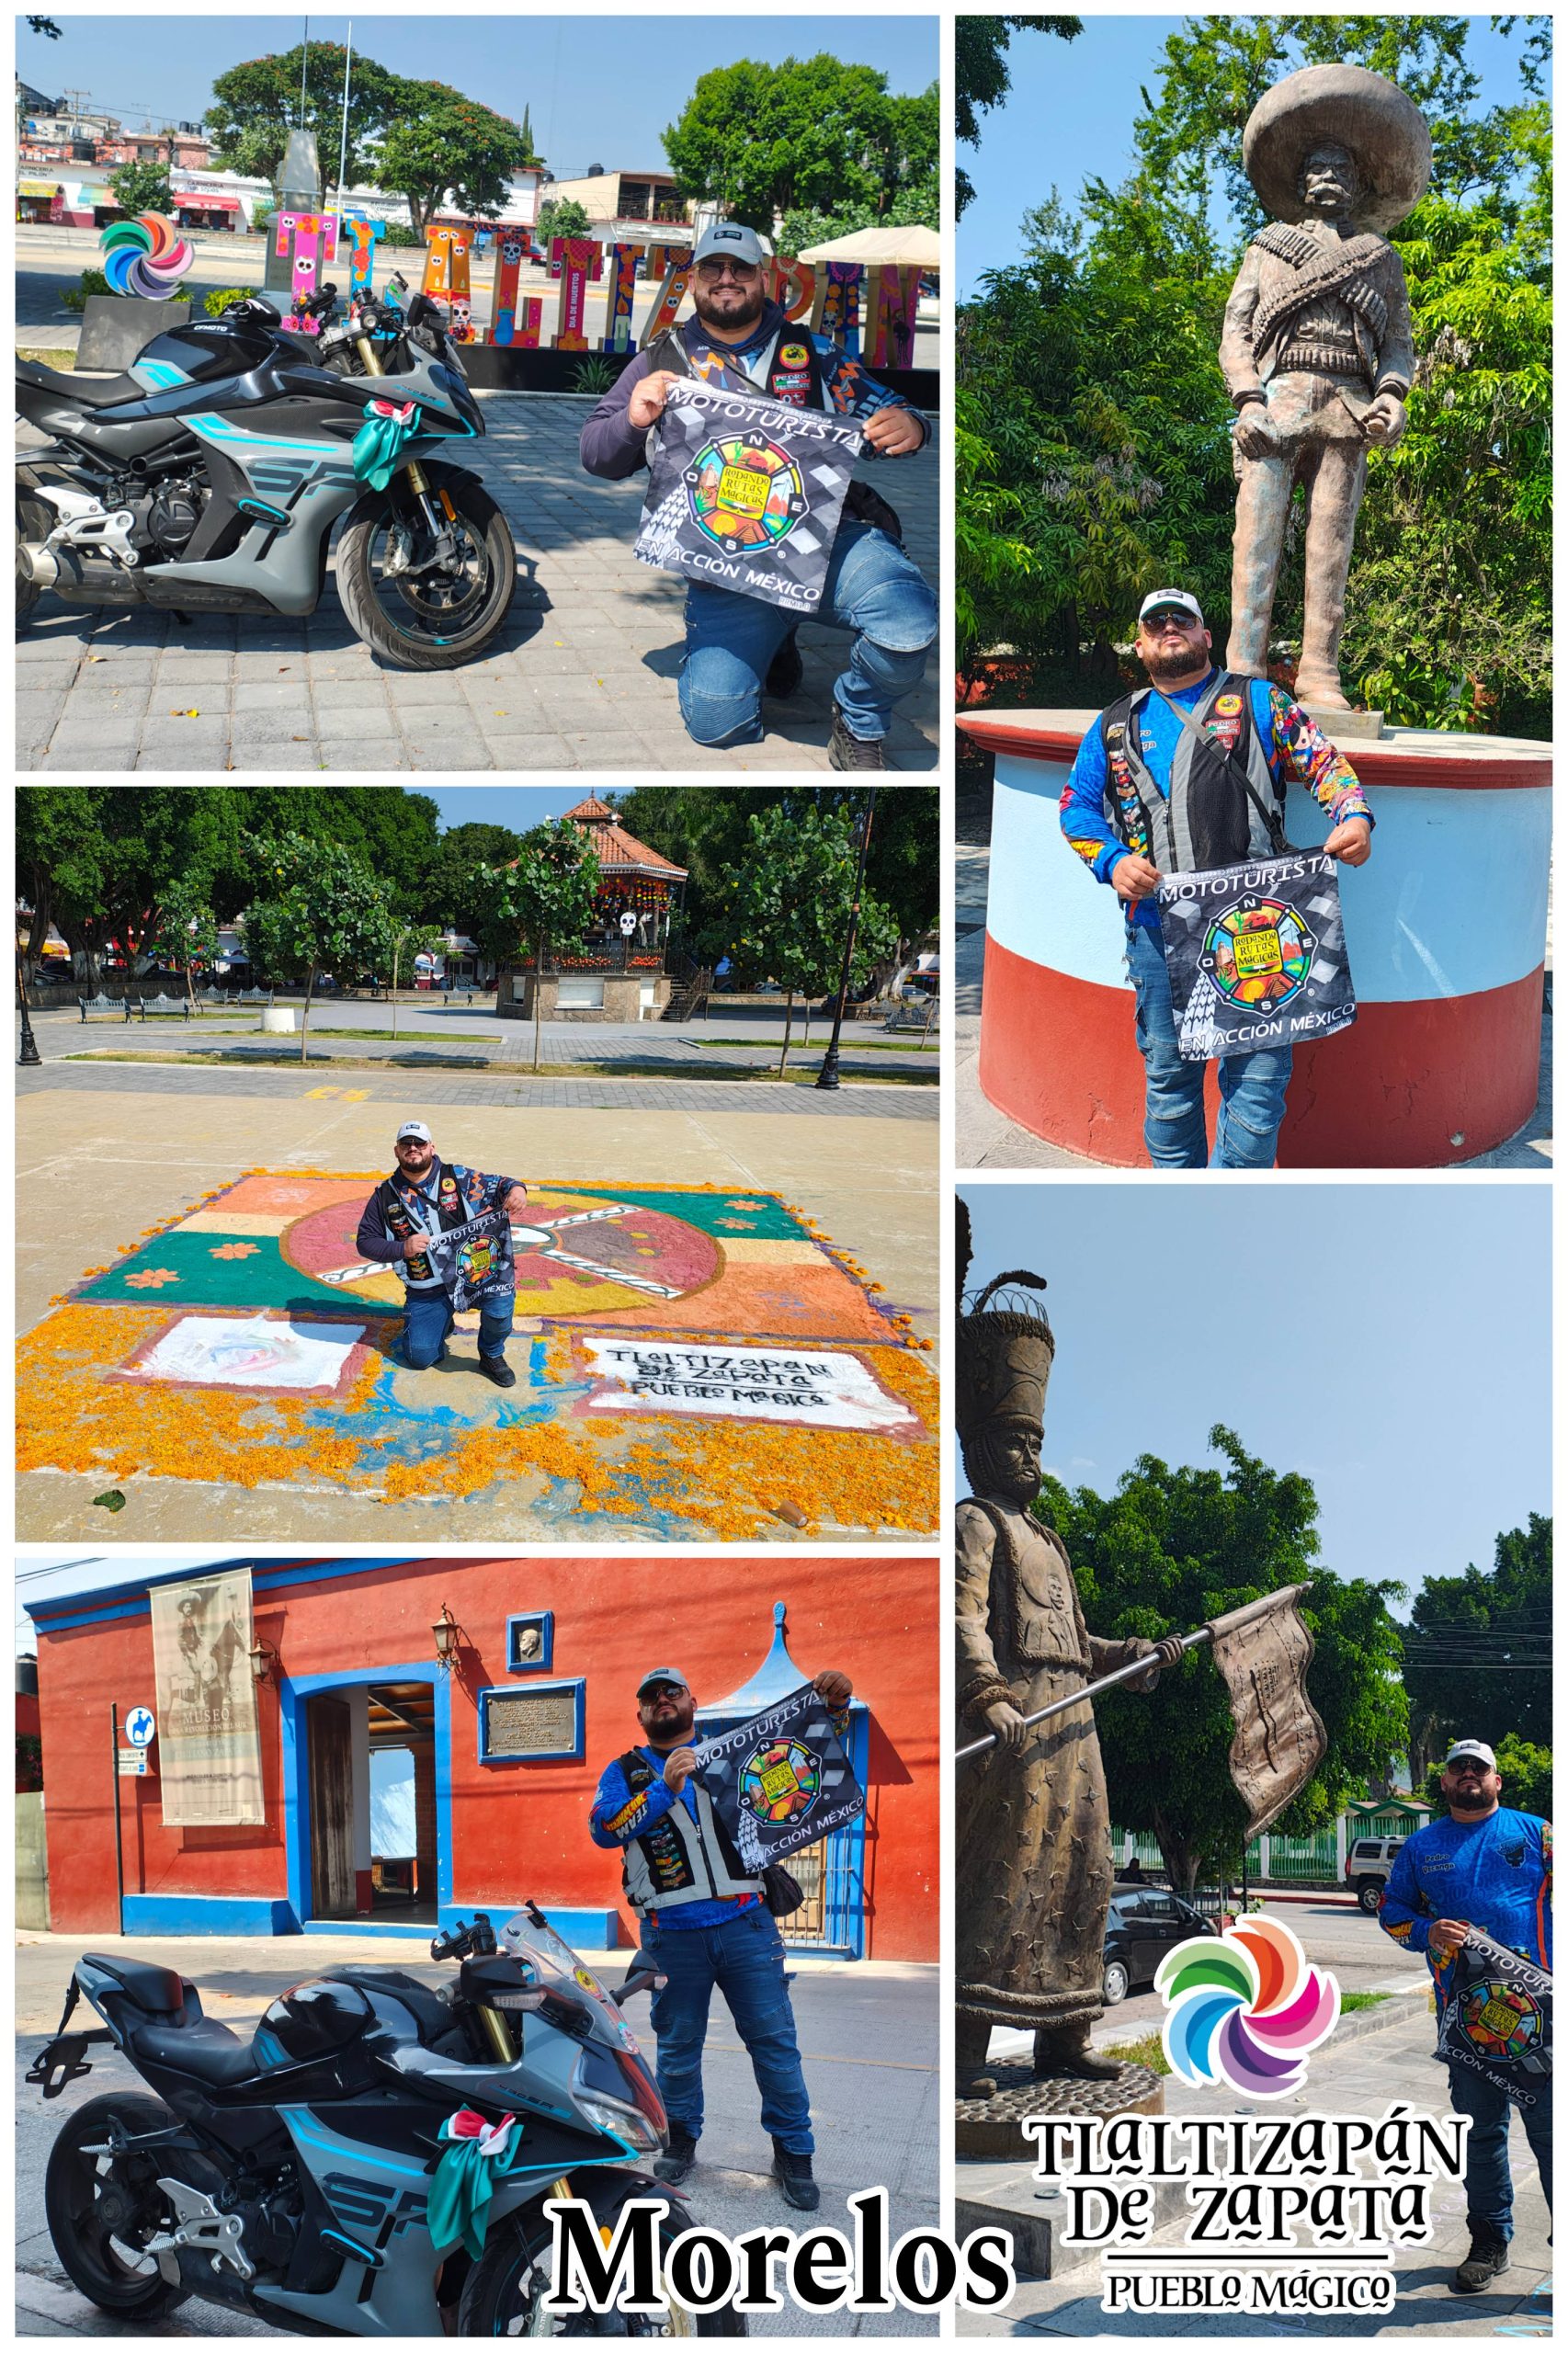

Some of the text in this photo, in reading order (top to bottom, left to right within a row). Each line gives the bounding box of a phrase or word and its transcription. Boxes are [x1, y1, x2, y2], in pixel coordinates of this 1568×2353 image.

[568, 272, 580, 328] DIA DE MUERTOS
[777, 373, 807, 381] PEDRO
[669, 386, 862, 448] MOTOTURISTA
[748, 435, 764, 447] N
[687, 472, 699, 483] O
[791, 501, 803, 512] E
[725, 539, 737, 551] S
[636, 539, 821, 601] EN ACCIÓN MÉXICO
[1159, 854, 1335, 904] MOTOTURISTA
[1243, 898, 1256, 909] N
[1302, 938, 1313, 948] E
[1202, 958, 1214, 967] O
[1260, 1001, 1272, 1011] S
[1180, 1002, 1356, 1053] EN ACCIÓN MÉXICO
[429, 1210, 508, 1251] MOTOTURISTA
[184, 1708, 230, 1724] MUSEO
[696, 1688, 820, 1768] MOTOTURISTA
[817, 1796, 864, 1830] MÉXICO
[1425, 1853, 1449, 1862] Pedro
[1485, 2072, 1537, 2105] MÉXICO
